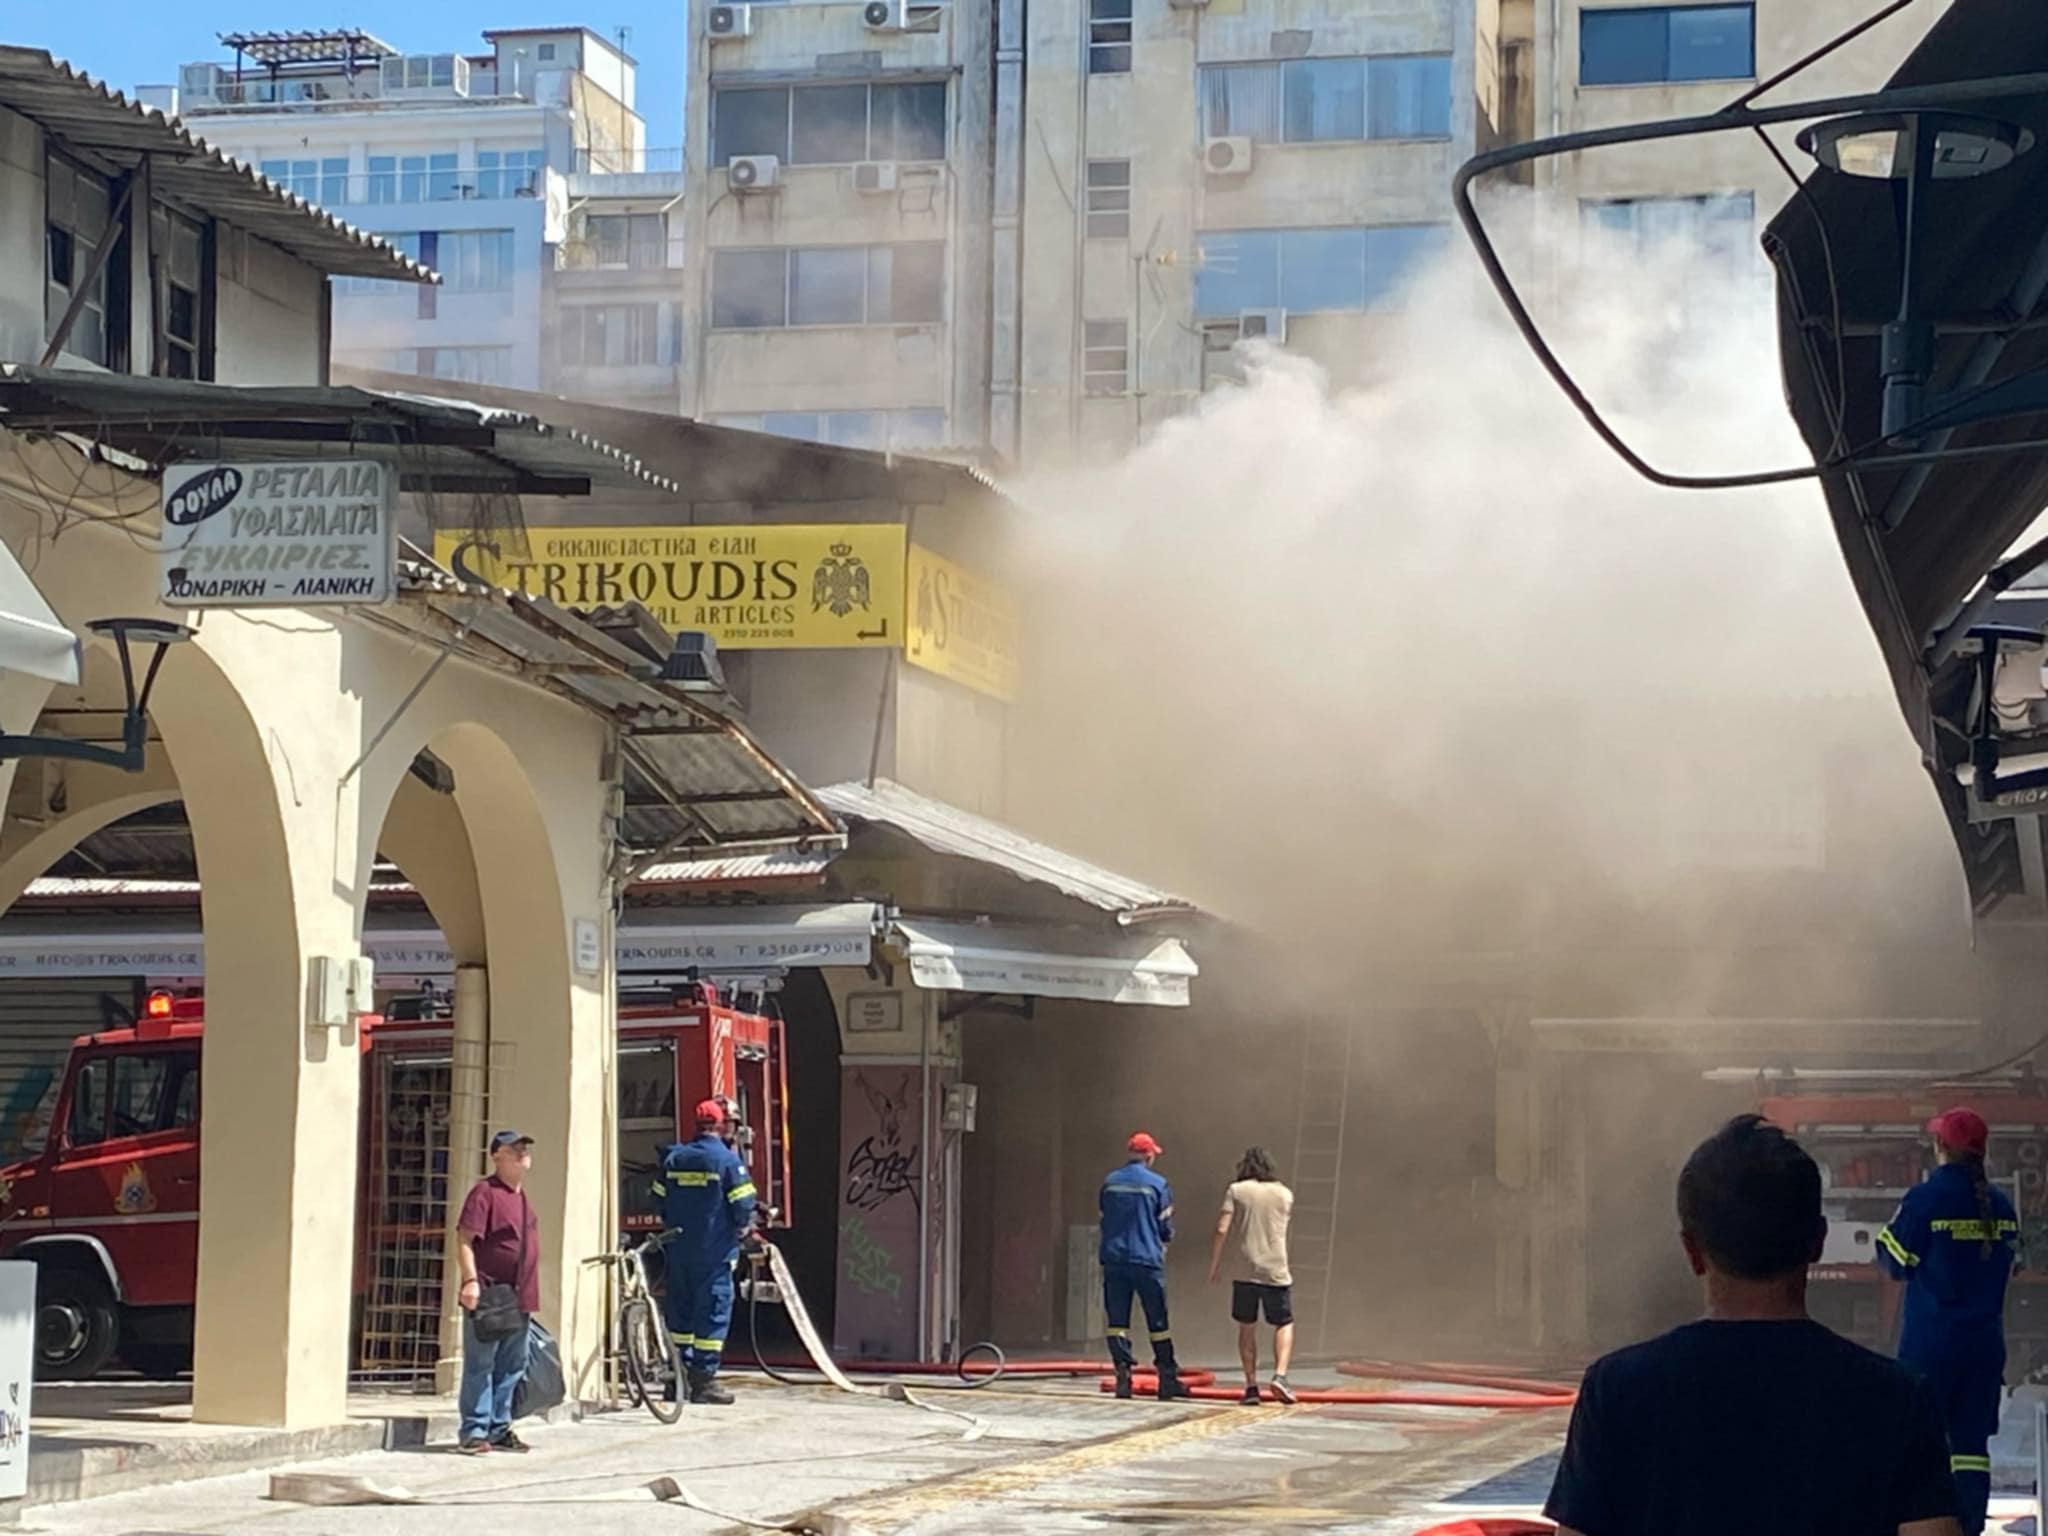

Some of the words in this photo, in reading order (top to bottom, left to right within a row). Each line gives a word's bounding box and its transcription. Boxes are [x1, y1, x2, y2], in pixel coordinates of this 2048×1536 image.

[171, 470, 237, 522] ΡΟΥΛΑ
[248, 467, 379, 498] ΡΕΤΑΛΙΑ
[228, 504, 378, 538] ΥΦΑΣΜΑΤΑ
[166, 579, 266, 598] ΧΟΝΔΡΙΚΗ
[292, 578, 375, 596] ΛΙΑΝΙΚΗ
[695, 604, 795, 625] ARTICLES
